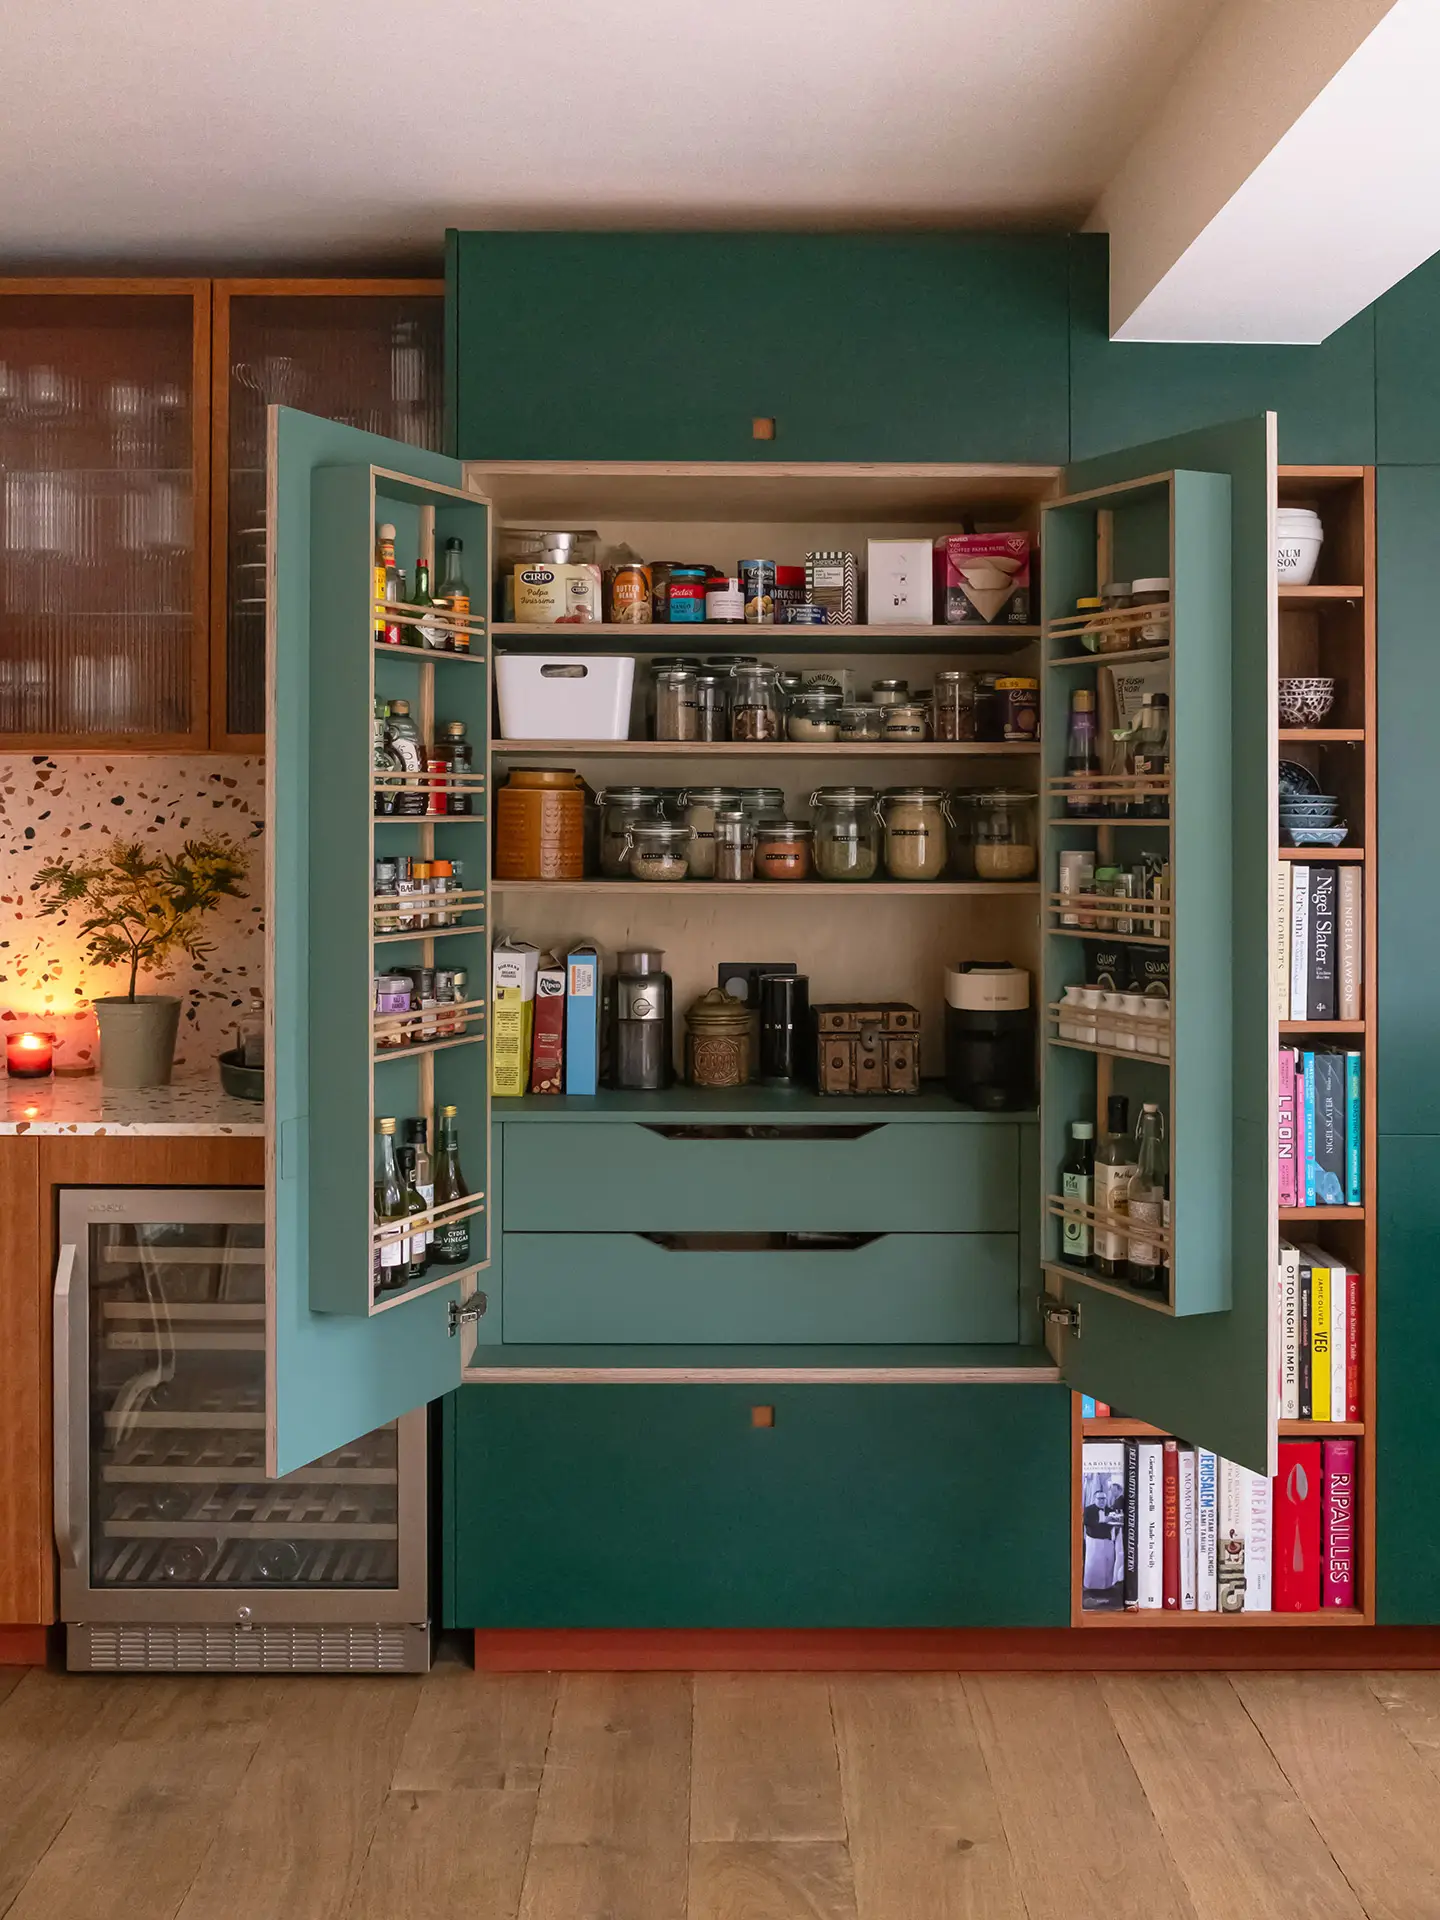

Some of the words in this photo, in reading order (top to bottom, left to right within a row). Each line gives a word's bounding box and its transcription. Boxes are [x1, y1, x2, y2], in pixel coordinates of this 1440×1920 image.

[1277, 549, 1301, 558] NUM
[1277, 558, 1297, 567] SON
[523, 572, 552, 581] CIRIO
[616, 584, 640, 593] BUTTER
[1125, 677, 1145, 685] SUSHI
[1311, 876, 1333, 916] Nigel
[1344, 874, 1353, 902] FEAST
[1295, 886, 1307, 938] Persiana
[1315, 920, 1333, 964] Slater
[1344, 906, 1353, 951] NIGELLA
[1096, 953, 1117, 965] QUAY
[540, 980, 560, 989] Alpen
[1344, 955, 1354, 1002] LAWSON
[1278, 1094, 1293, 1160] LEON
[448, 1229, 466, 1237] CYDER
[1286, 1265, 1295, 1339] OTTOLENGHI
[1314, 1331, 1328, 1353] VEG
[1349, 1318, 1357, 1342] Kitchen
[1286, 1344, 1295, 1385] SIMPLE
[1349, 1343, 1357, 1361] Table
[1128, 1448, 1137, 1470] DELIA
[1148, 1455, 1156, 1482] Giorgio
[1200, 1454, 1214, 1508] JERUSALEM
[1127, 1500, 1137, 1528] WINTER
[1165, 1476, 1176, 1538] CURRIES
[1184, 1472, 1192, 1535] MOMOFUKU
[1251, 1480, 1267, 1564] BREAKFAST
[1330, 1472, 1351, 1583] RIPAILLES
[1127, 1528, 1136, 1572] COLLECTION
[1147, 1550, 1156, 1569] Sicily
